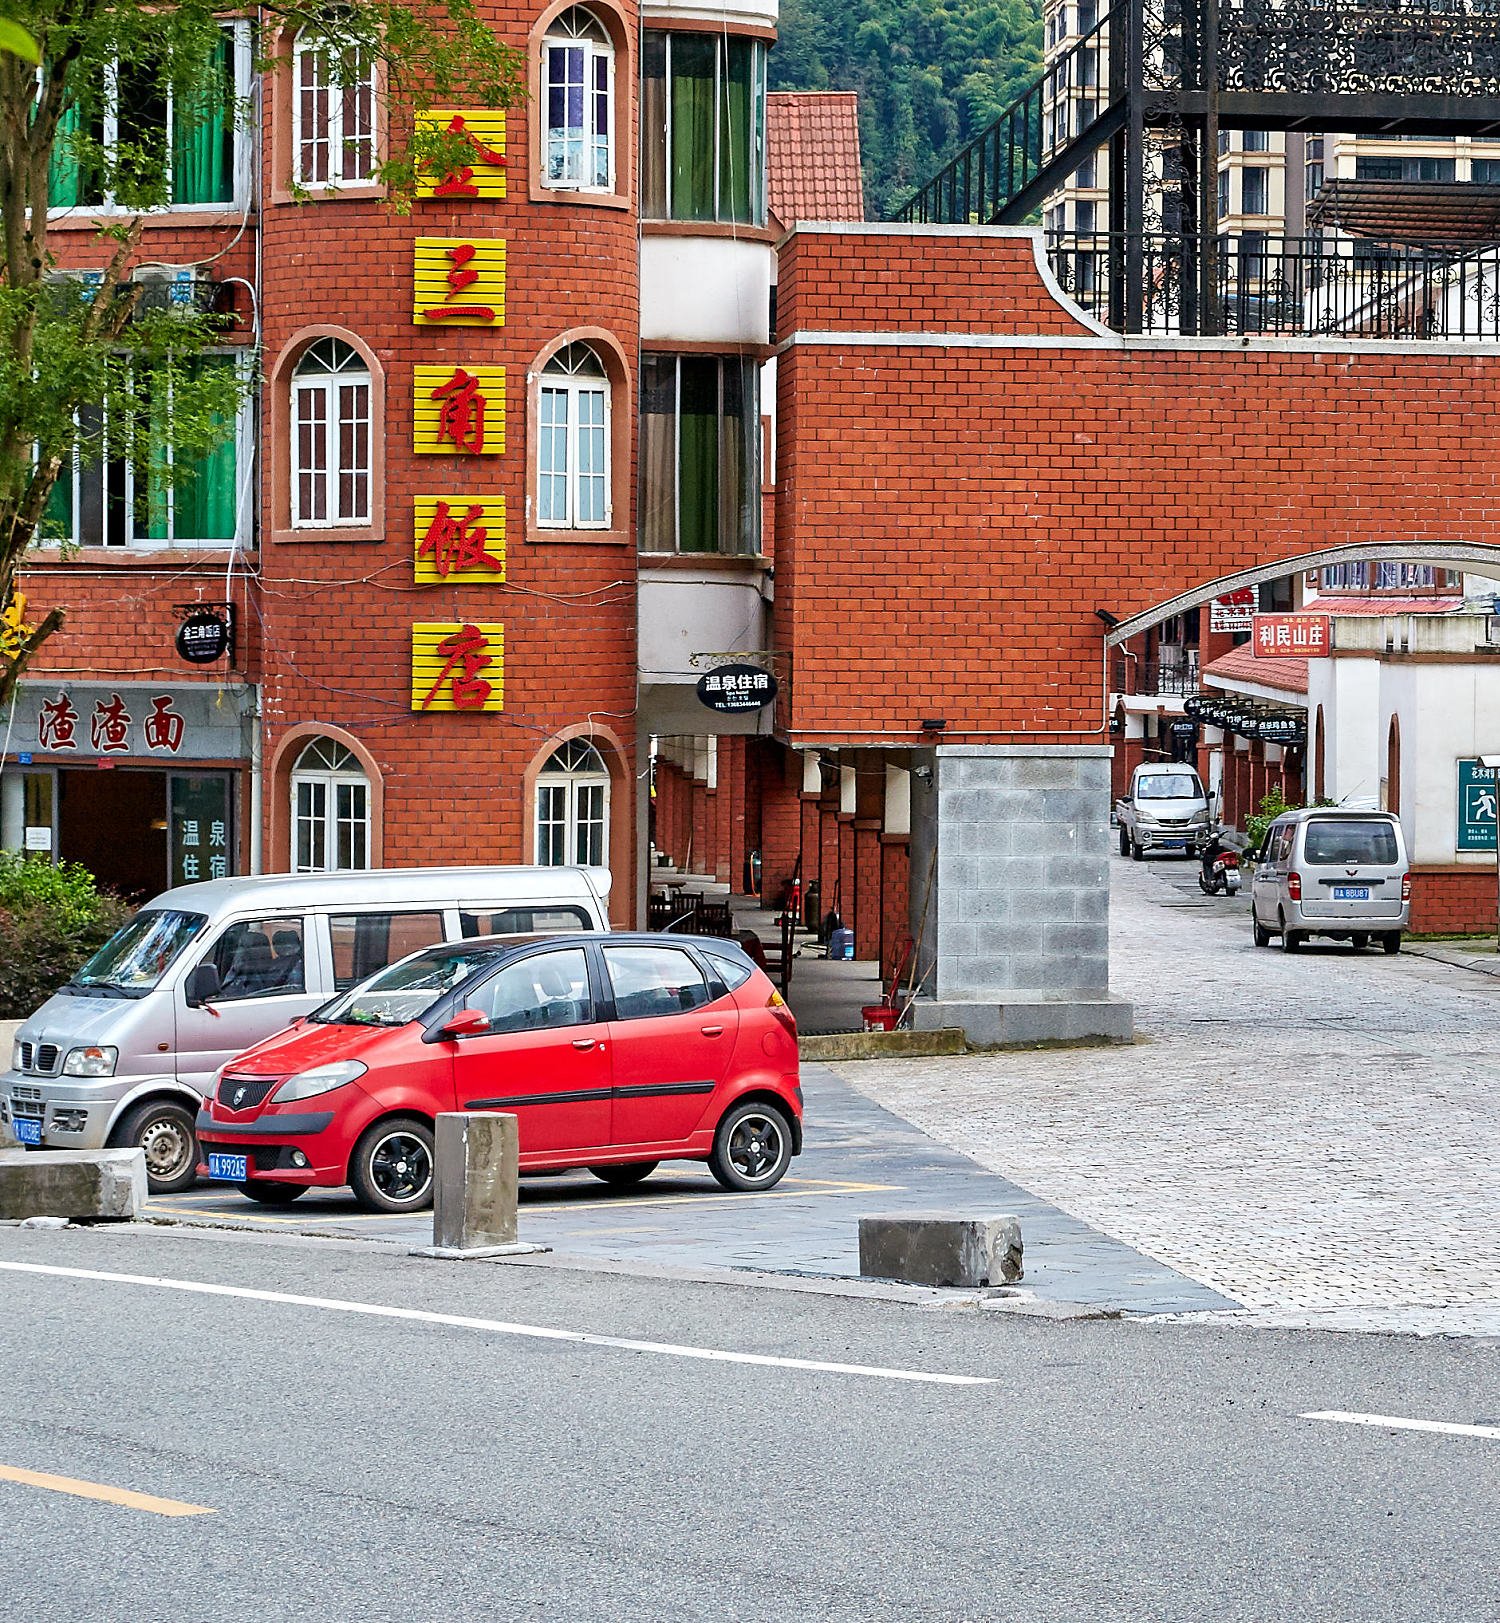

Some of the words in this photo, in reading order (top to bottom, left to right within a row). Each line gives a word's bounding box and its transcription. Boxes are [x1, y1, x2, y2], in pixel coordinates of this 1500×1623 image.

[416, 114, 508, 712] 金三角饭店
[1259, 624, 1324, 647] 利民山庄
[705, 673, 769, 691] 温泉住宿
[38, 692, 185, 753] 渣渣面
[182, 819, 226, 847] 温泉
[182, 854, 226, 880] 住宿
